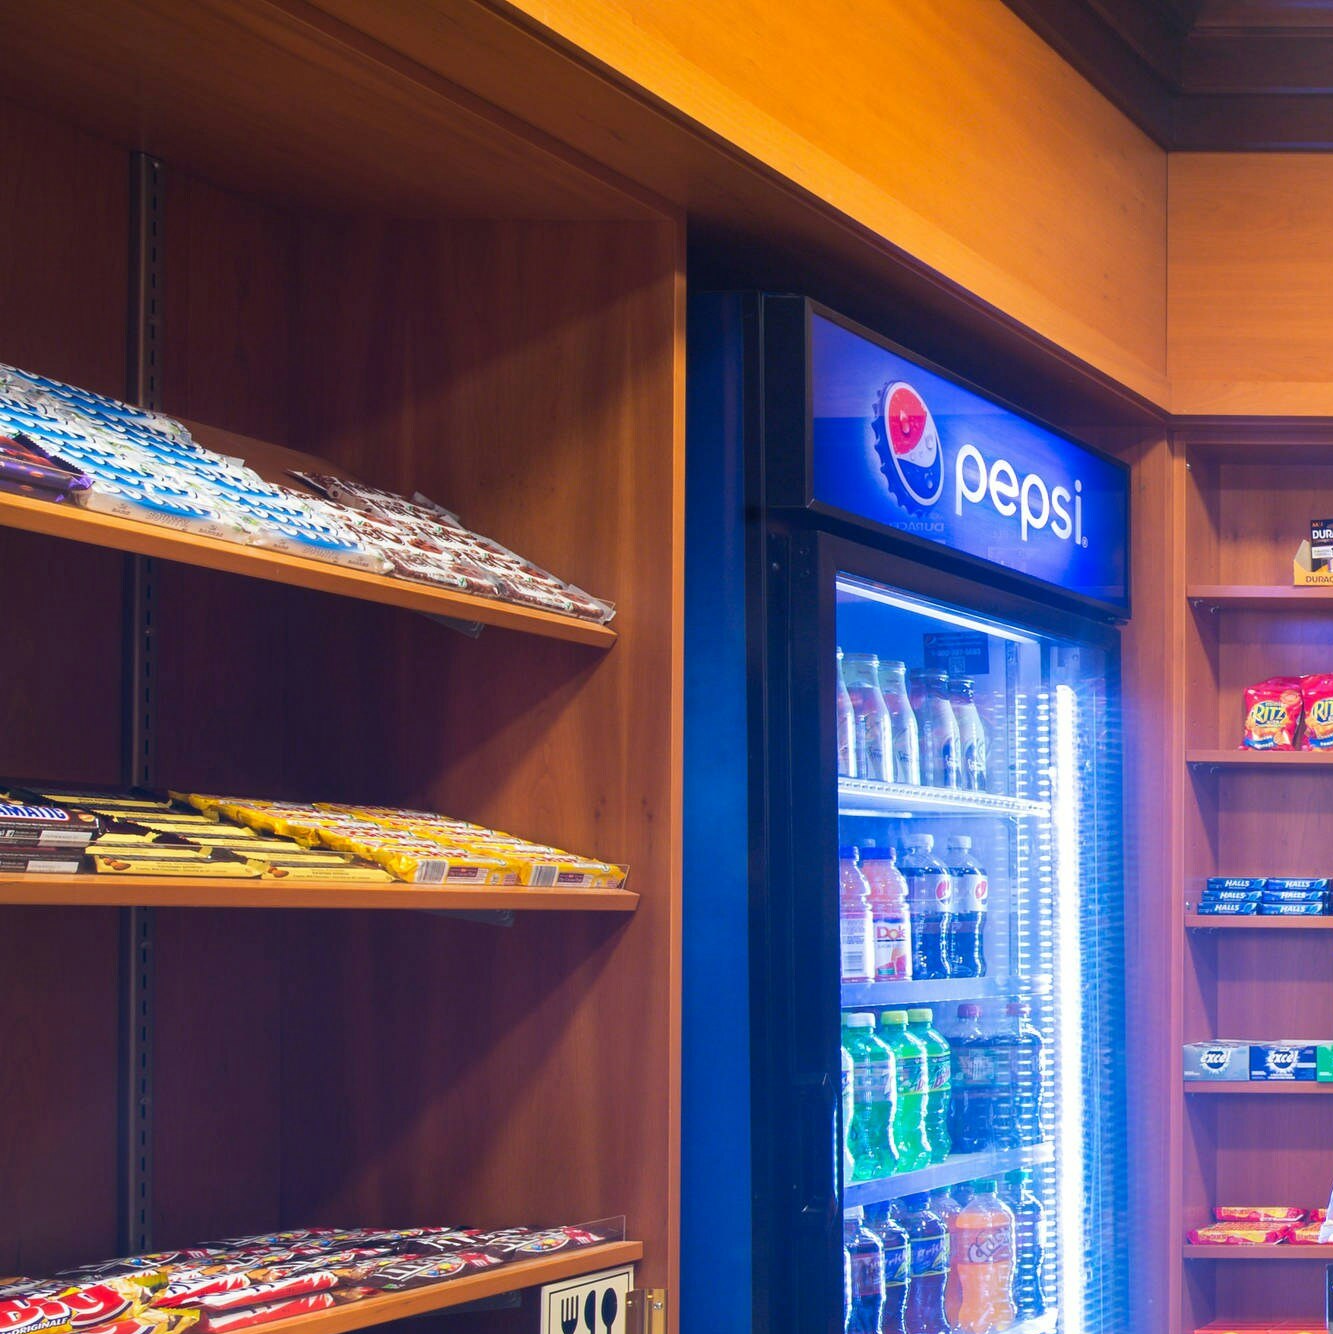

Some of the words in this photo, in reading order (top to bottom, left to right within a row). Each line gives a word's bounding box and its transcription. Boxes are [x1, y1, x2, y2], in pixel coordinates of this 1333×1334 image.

[955, 444, 1082, 544] pepsi
[1252, 705, 1287, 724] RITZ
[1281, 905, 1305, 913] HALLS
[1269, 1052, 1298, 1063] excel
